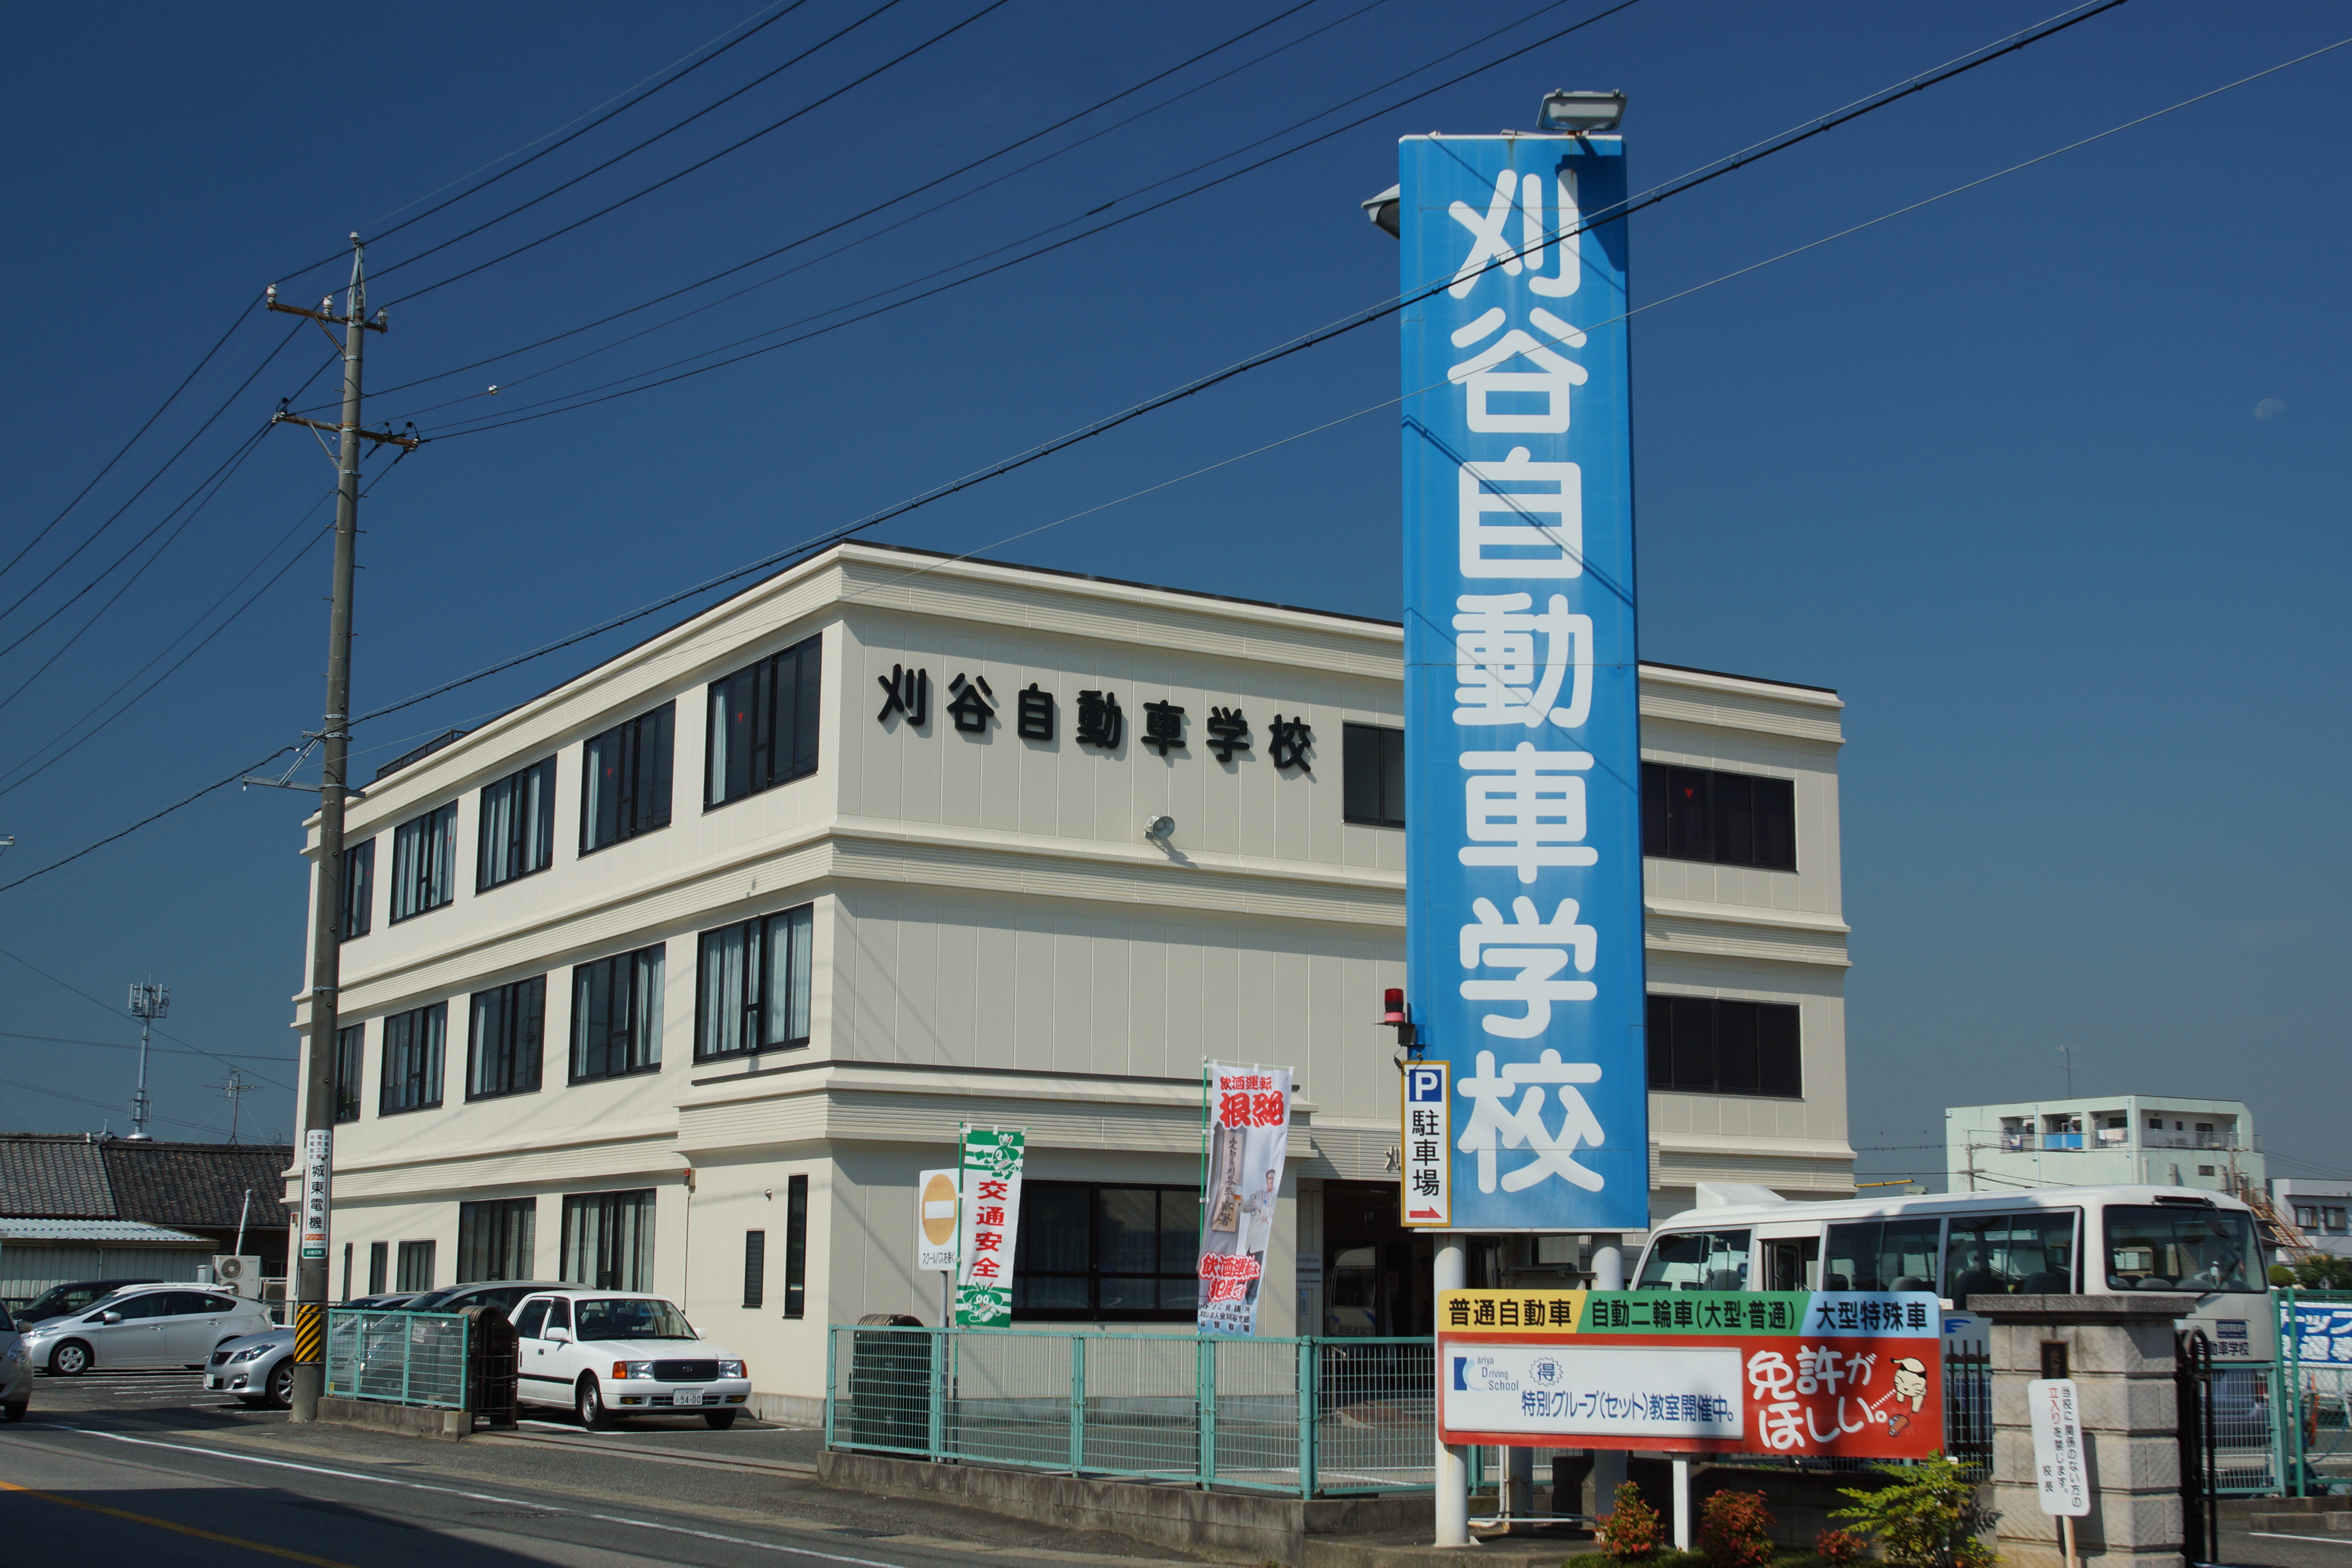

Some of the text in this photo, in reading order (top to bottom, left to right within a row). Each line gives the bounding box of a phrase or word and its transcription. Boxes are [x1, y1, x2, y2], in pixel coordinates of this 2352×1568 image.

[1448, 168, 1603, 1193] 刈谷自動車学校
[877, 663, 1312, 773] 刈谷自動車学校
[1220, 1075, 1272, 1091] 飲酒運転
[1416, 1072, 1438, 1100] P
[1219, 1090, 1284, 1128] 根絶
[1412, 1109, 1440, 1197] 駐車場
[309, 1164, 325, 1229] 城東電機
[972, 1180, 1008, 1278] 交通安全
[922, 1251, 955, 1265] スクールバスを除く
[1201, 1254, 1259, 1278] 飲酒運転は
[1210, 1278, 1246, 1299] 犯罪です
[1448, 1298, 1572, 1327] 普通自動車
[1816, 1300, 1928, 1331] 大型特殊車
[1477, 1356, 1494, 1366] ariya
[1537, 1363, 1555, 1381] 得
[1747, 1345, 1877, 1400] 免許が
[680, 1396, 701, 1404] 94-00
[1488, 1380, 1519, 1391] School
[1521, 1390, 1734, 1423] 特別グループ(セット)教室開催中。
[1759, 1395, 1888, 1450] ほしい。
[2048, 1387, 2068, 1493] 立入りを禁じます。
[2061, 1386, 2081, 1508] 当校に関係のない方の
[2042, 1465, 2054, 1493] 校長
